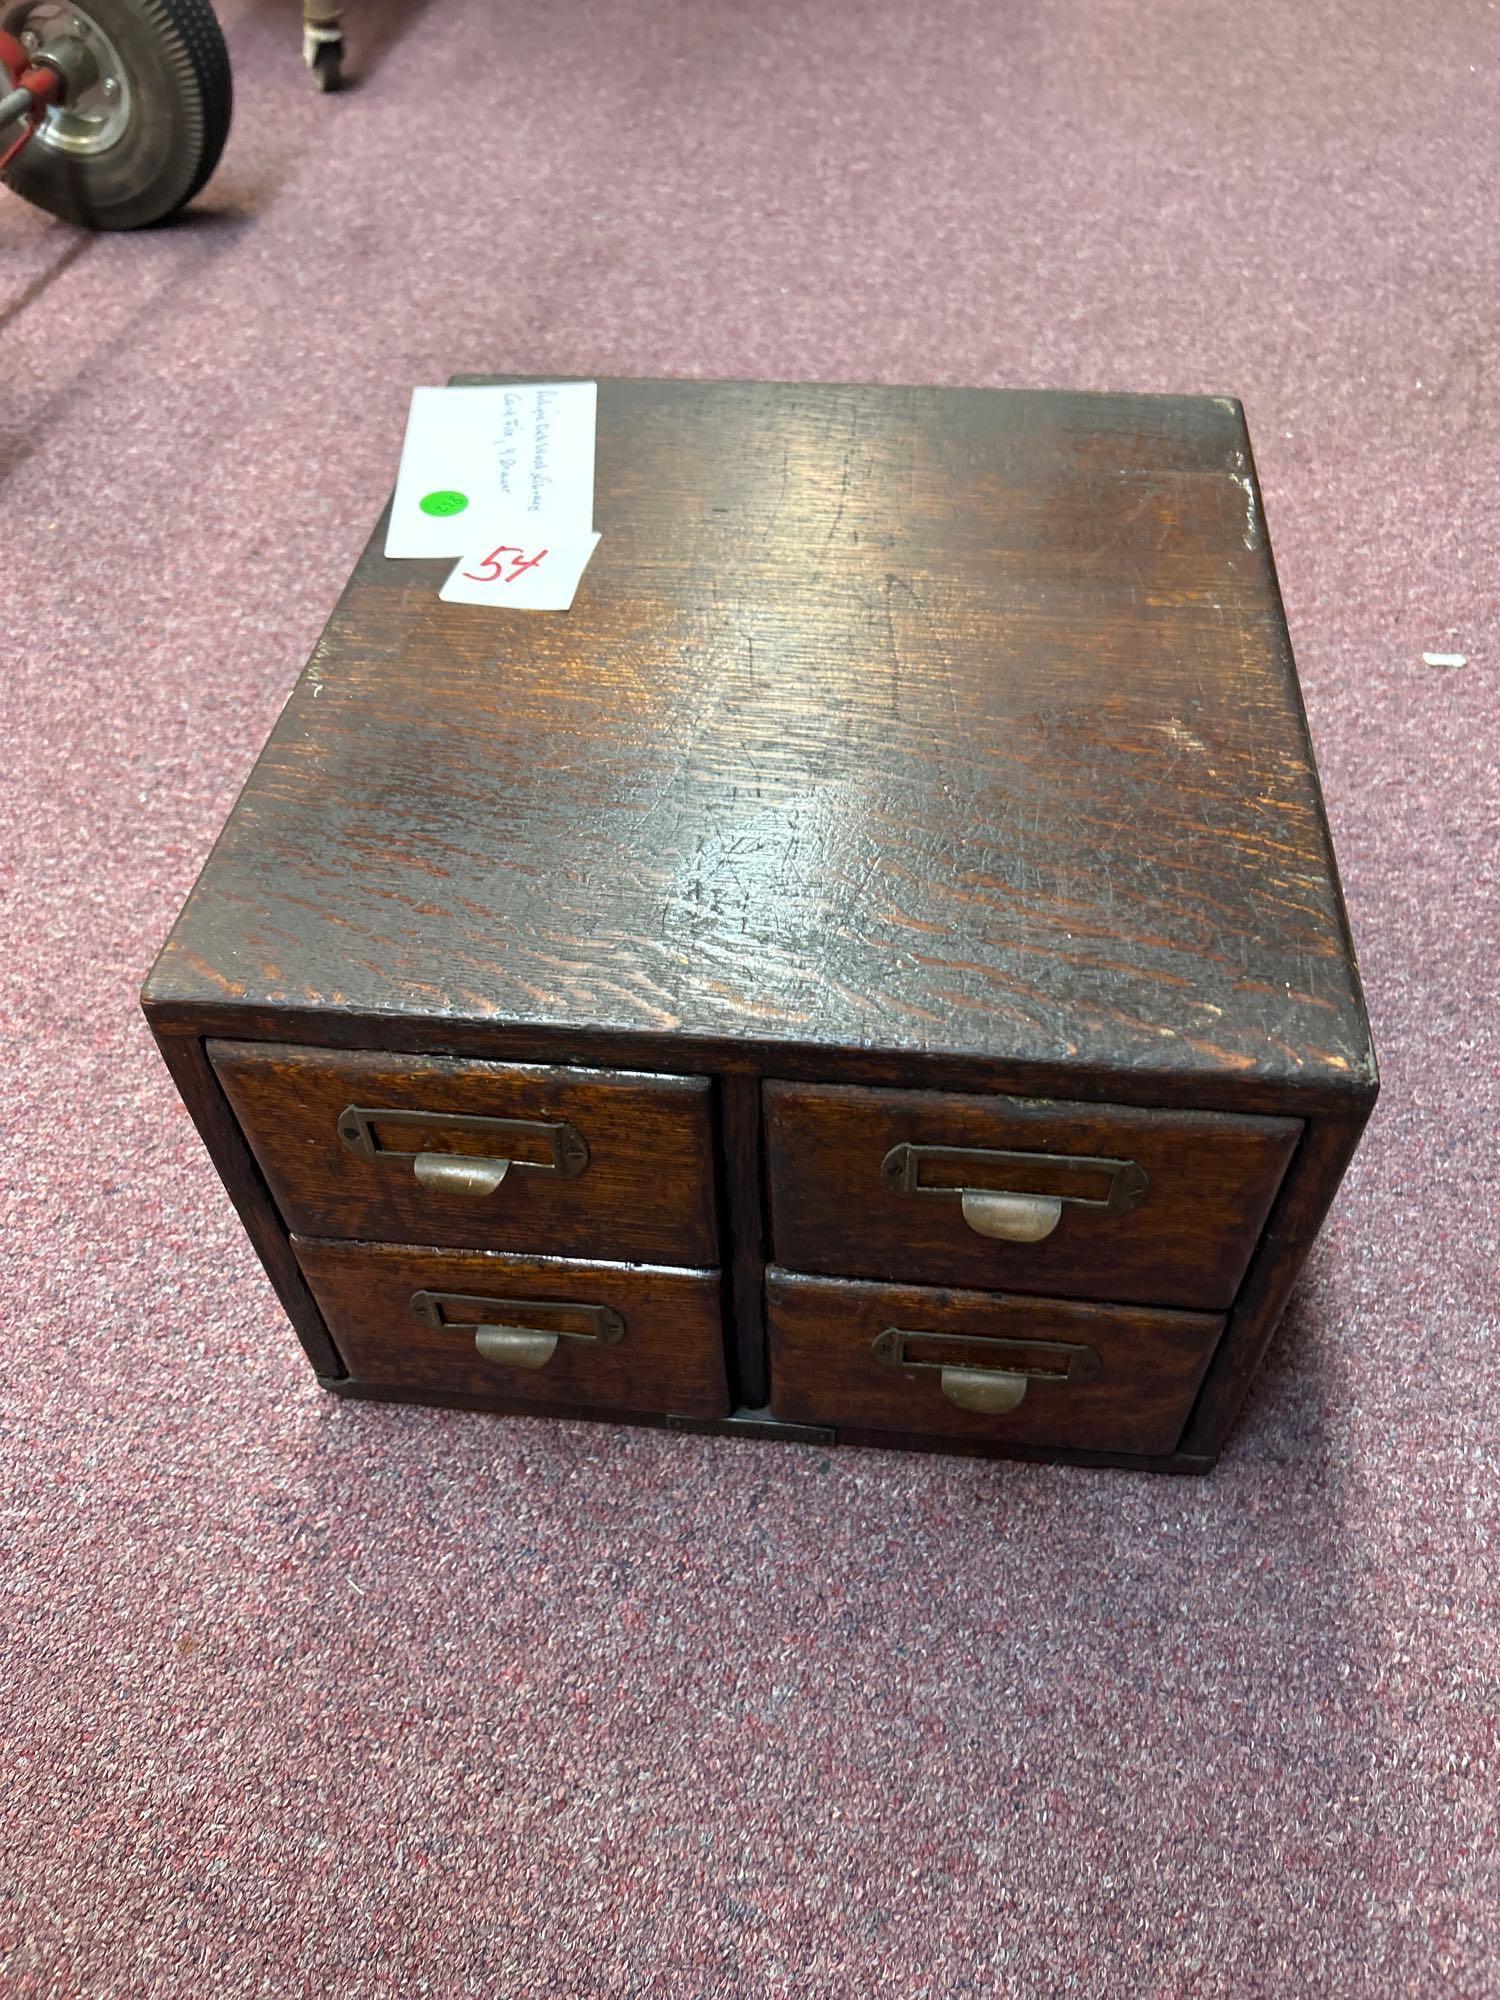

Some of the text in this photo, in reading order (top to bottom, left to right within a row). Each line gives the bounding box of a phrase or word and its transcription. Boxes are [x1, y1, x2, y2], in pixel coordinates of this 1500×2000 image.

[502, 393, 523, 416] Card
[499, 459, 516, 494] Drawer
[526, 472, 553, 512] Library
[462, 545, 548, 582] 54
